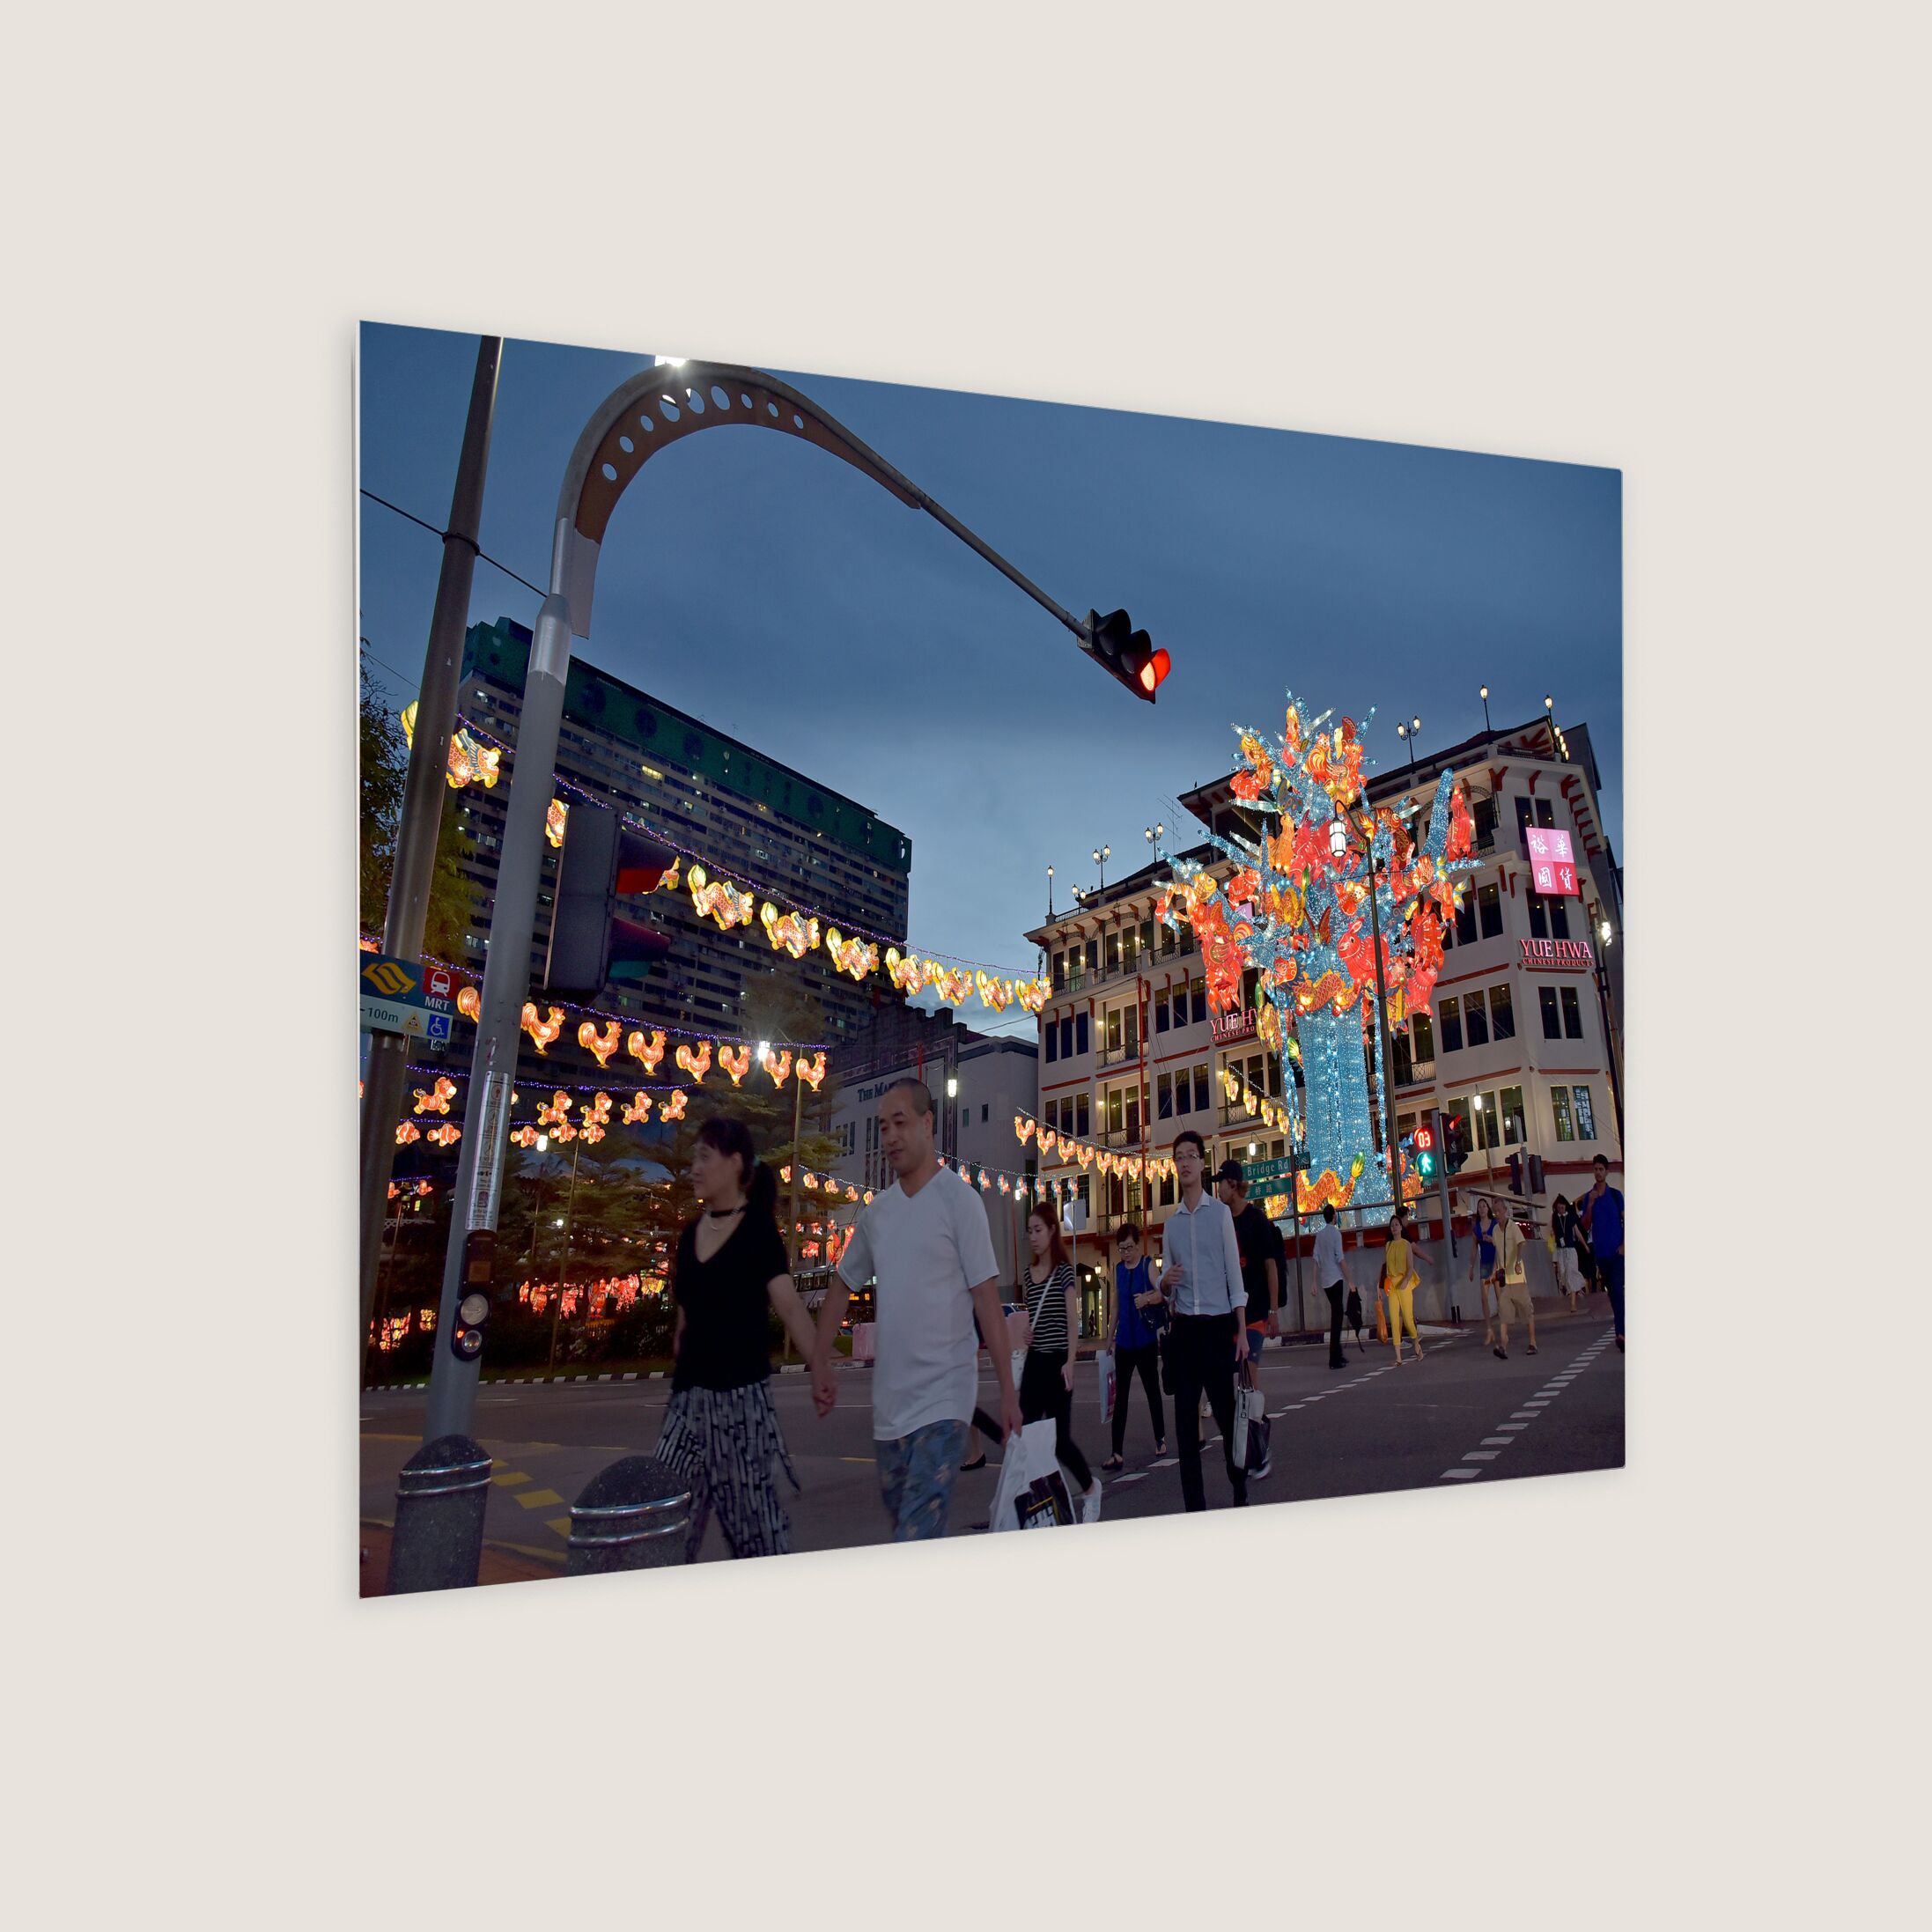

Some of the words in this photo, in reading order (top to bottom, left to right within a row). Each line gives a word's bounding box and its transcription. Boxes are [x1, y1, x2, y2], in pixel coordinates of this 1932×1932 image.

[1520, 939, 1553, 957] YUE
[1555, 940, 1593, 959] HWA
[1523, 957, 1555, 966] CHINESE
[424, 996, 450, 1011] MRT
[367, 1007, 399, 1023] 100m
[1210, 1013, 1238, 1035] YUE
[1242, 1008, 1258, 1026] H
[1210, 1029, 1240, 1043] CHINESE
[874, 1081, 896, 1098] MA
[1418, 1131, 1431, 1147] 03
[1247, 1163, 1275, 1176] Bridge
[1278, 1159, 1288, 1171] Rd
